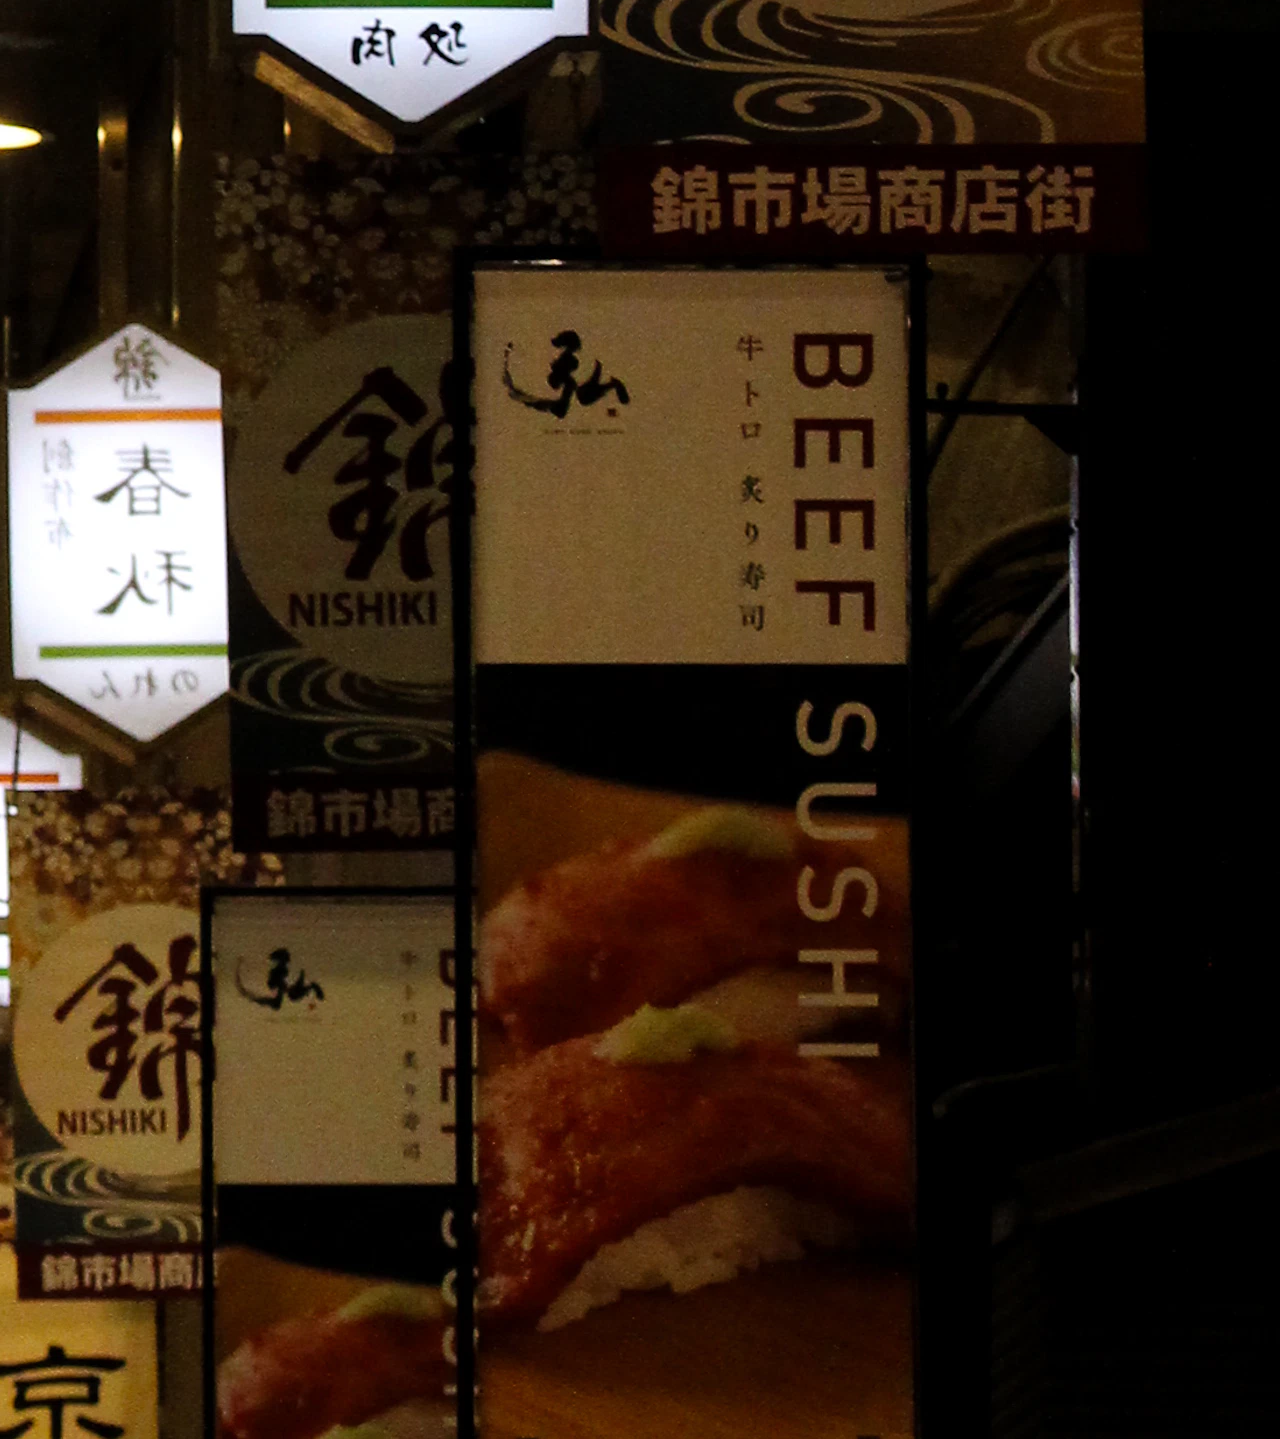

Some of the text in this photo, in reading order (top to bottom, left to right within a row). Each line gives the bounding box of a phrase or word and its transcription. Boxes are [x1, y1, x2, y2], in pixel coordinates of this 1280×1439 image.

[651, 166, 1095, 236] 錦市場商店街
[288, 594, 438, 627] NISHIKI
[793, 332, 879, 1059] BEEF SUSHI
[56, 1108, 168, 1137] NISHIKI
[42, 1250, 205, 1292] 錦市場商
